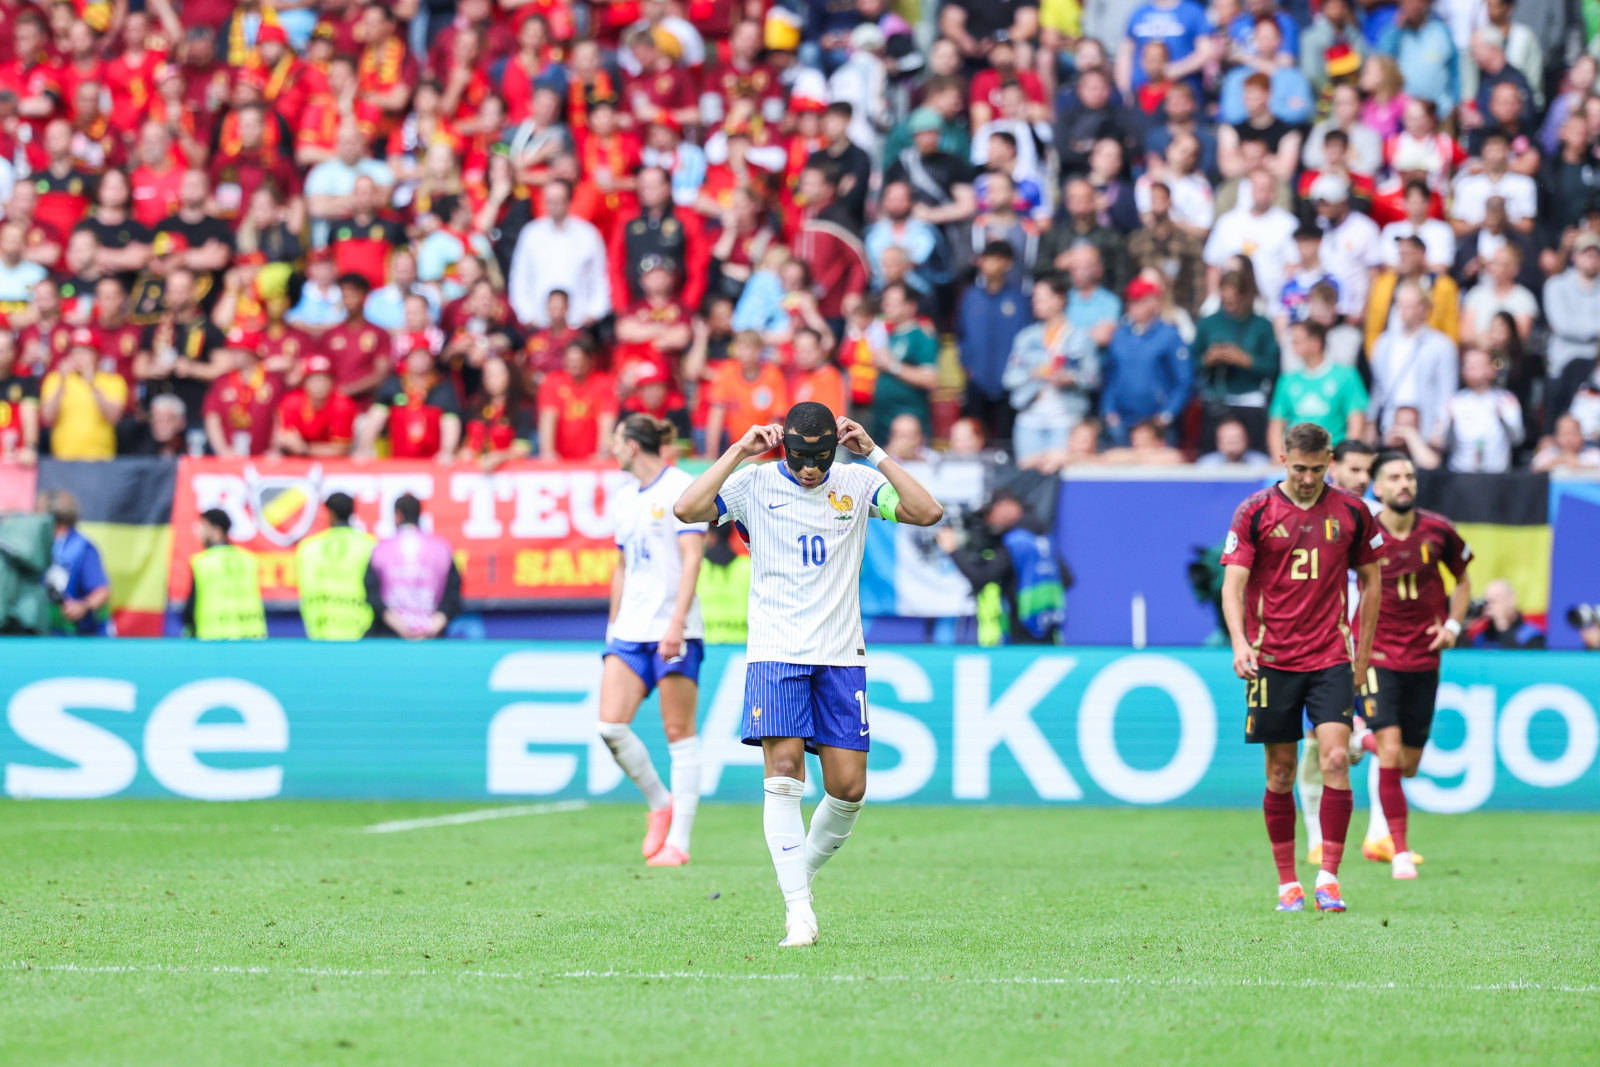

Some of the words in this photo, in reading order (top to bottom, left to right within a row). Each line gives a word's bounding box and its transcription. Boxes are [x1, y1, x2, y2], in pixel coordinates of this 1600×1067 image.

[797, 534, 826, 567] 10
[1290, 547, 1319, 581] 21
[1397, 571, 1419, 601] 11
[1247, 676, 1269, 709] 21
[5, 677, 289, 799] se
[1401, 681, 1599, 815] go
